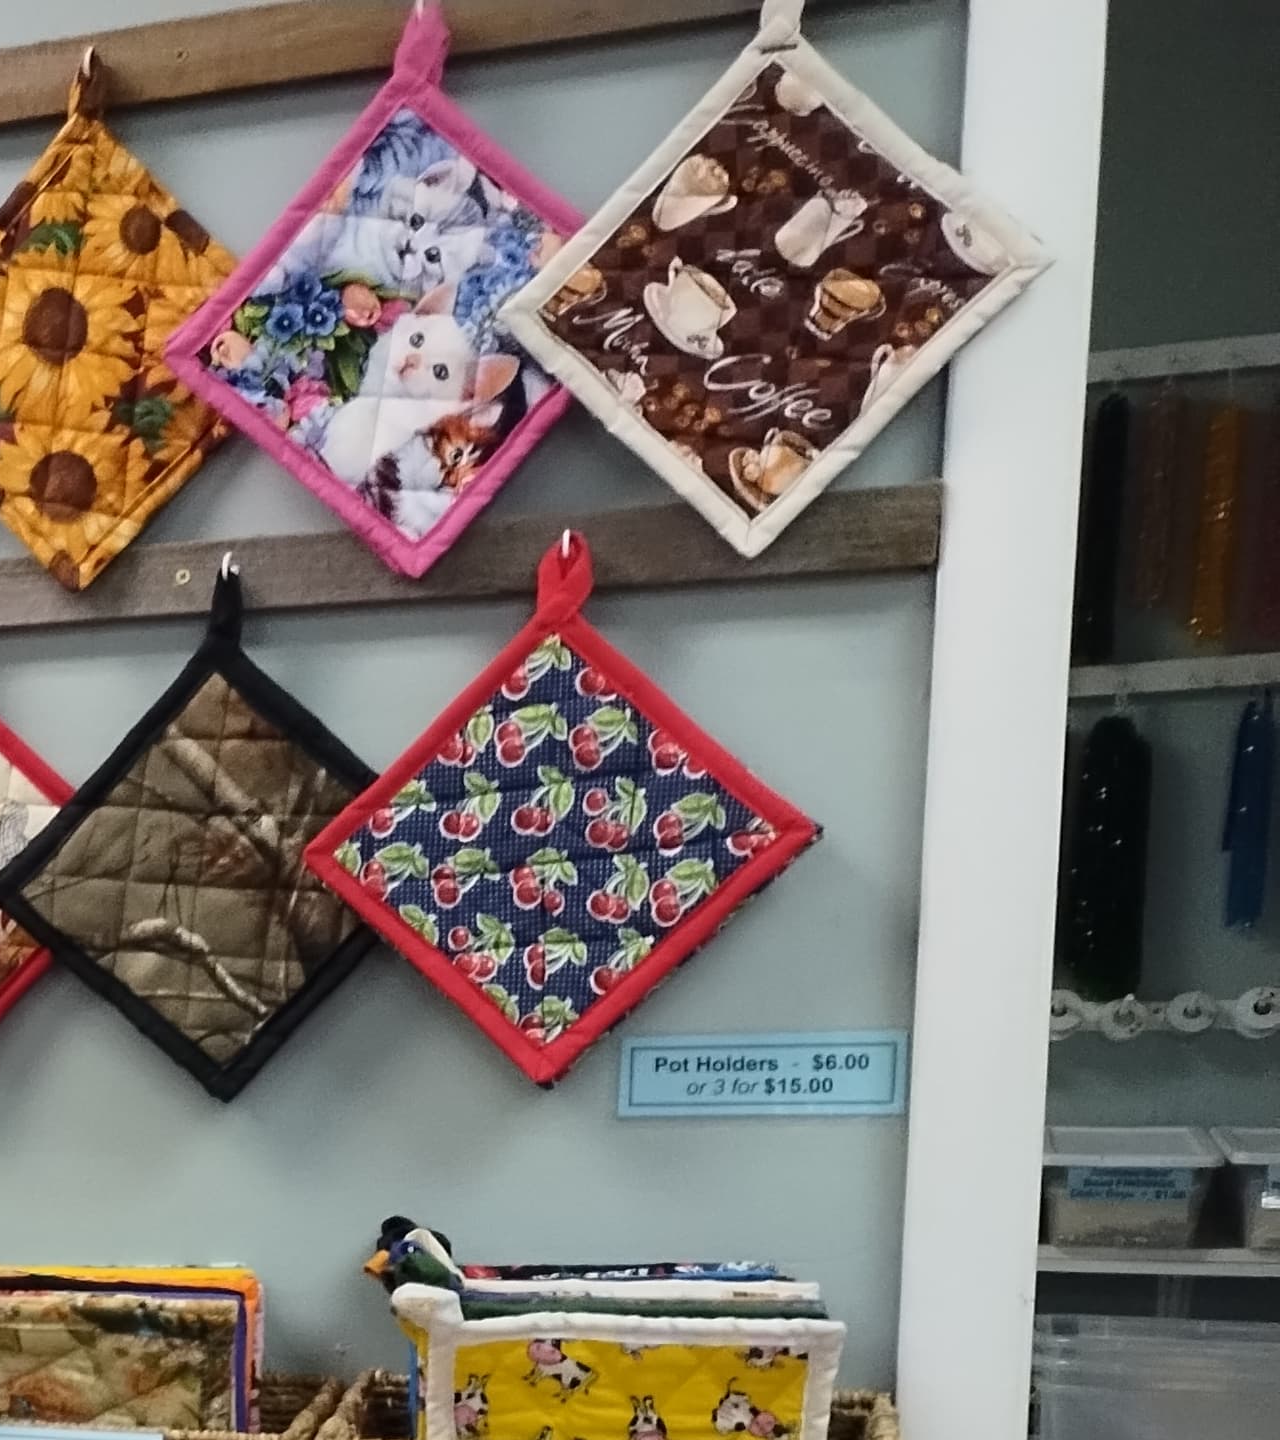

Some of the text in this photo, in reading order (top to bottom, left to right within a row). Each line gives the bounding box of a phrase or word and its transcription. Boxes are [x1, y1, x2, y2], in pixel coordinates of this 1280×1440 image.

[703, 354, 835, 430] Coffee
[654, 1057, 689, 1073] Pot
[695, 1055, 779, 1072] Holders
[811, 1053, 870, 1071] $6.00
[686, 1077, 834, 1096] or 3 for $15.00
